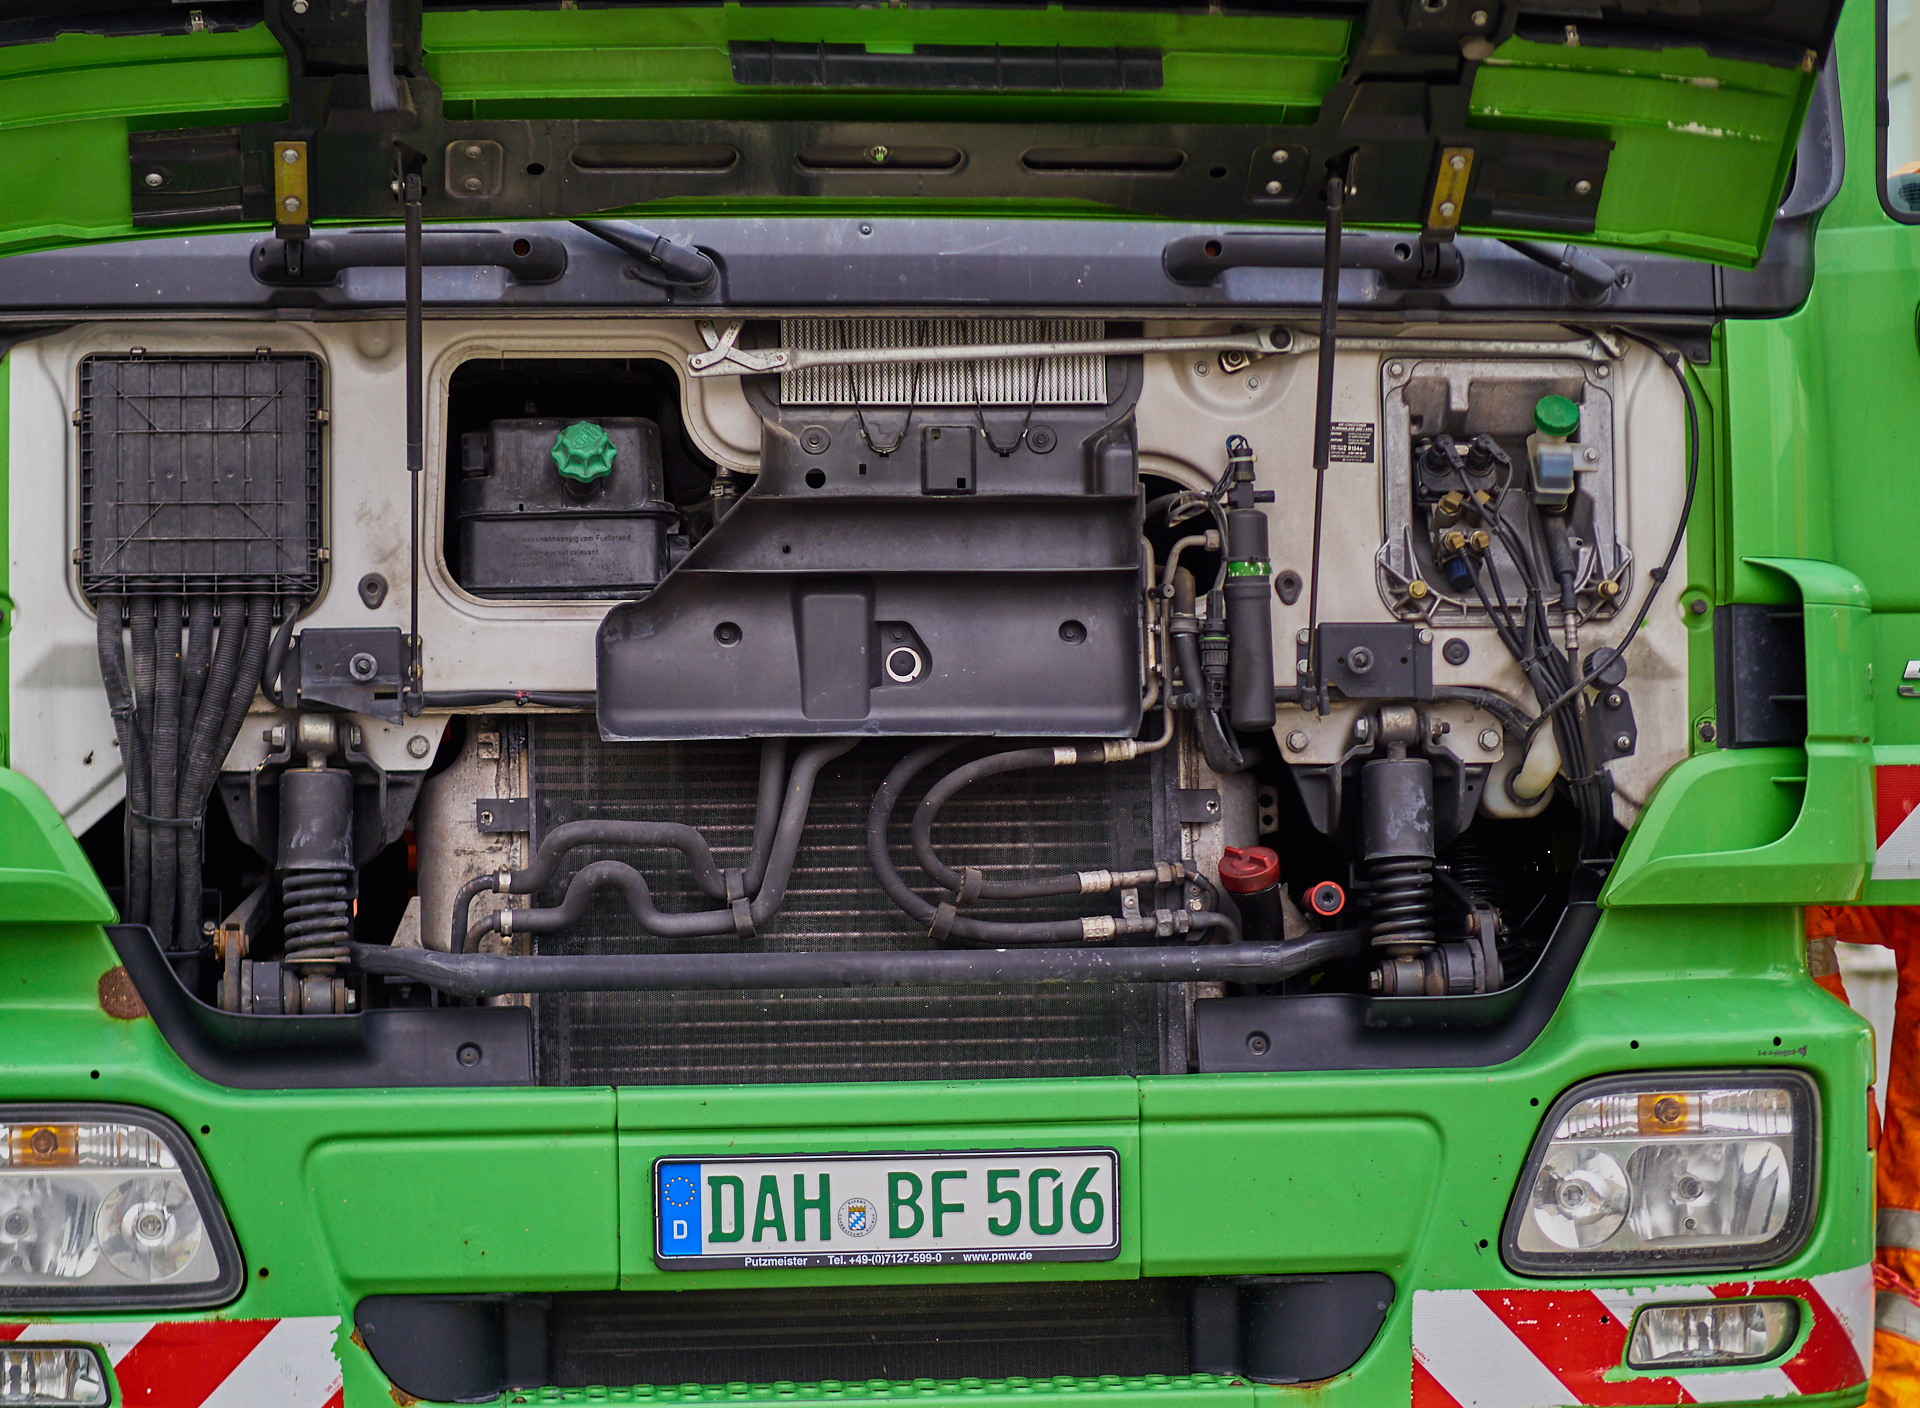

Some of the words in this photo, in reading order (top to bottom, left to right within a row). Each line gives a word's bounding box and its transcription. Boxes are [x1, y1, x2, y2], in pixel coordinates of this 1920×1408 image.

[536, 535, 579, 544] unabhaengig
[596, 534, 631, 542] Fuellstand
[673, 1219, 688, 1240] D
[707, 1173, 831, 1243] DAH
[887, 1170, 967, 1239] BF
[987, 1167, 1104, 1236] 506
[744, 1256, 808, 1267] Putzmeister
[827, 1254, 847, 1265] Tel.
[849, 1252, 942, 1265] +49-(0)7127-599-0
[963, 1250, 1033, 1262] www.pmw.de
